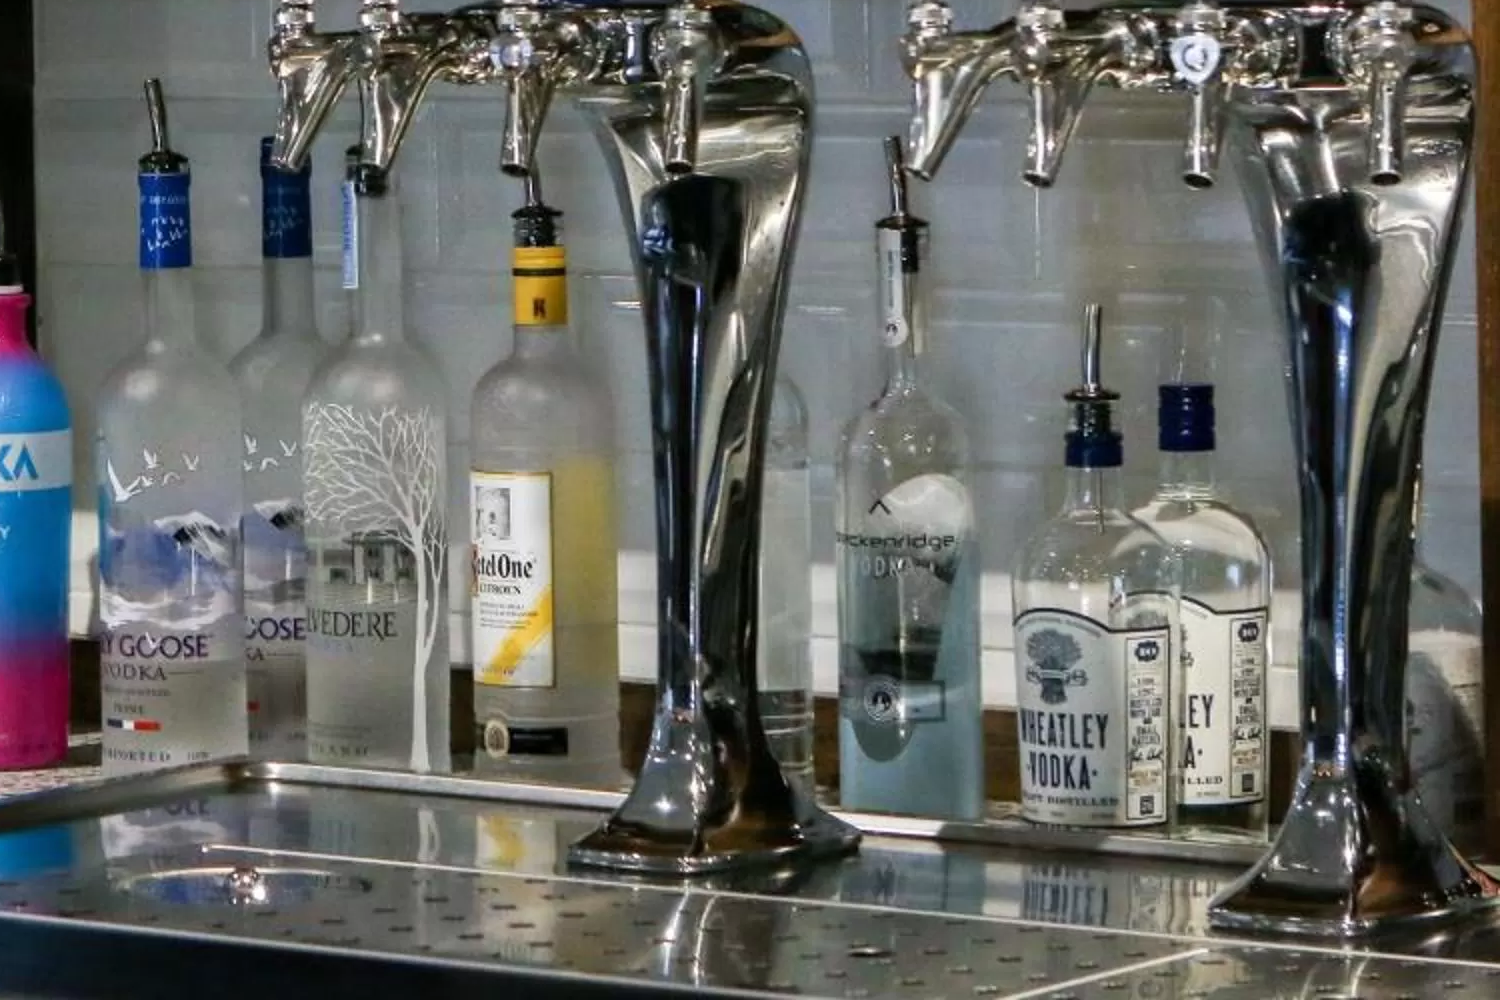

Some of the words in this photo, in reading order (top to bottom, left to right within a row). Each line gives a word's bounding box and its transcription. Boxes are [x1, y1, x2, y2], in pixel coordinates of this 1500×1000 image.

[498, 553, 533, 579] One
[859, 555, 915, 577] ODKA
[306, 607, 399, 641] LVEDERE
[119, 633, 209, 659] GOOSE
[1029, 750, 1091, 790] VODKA
